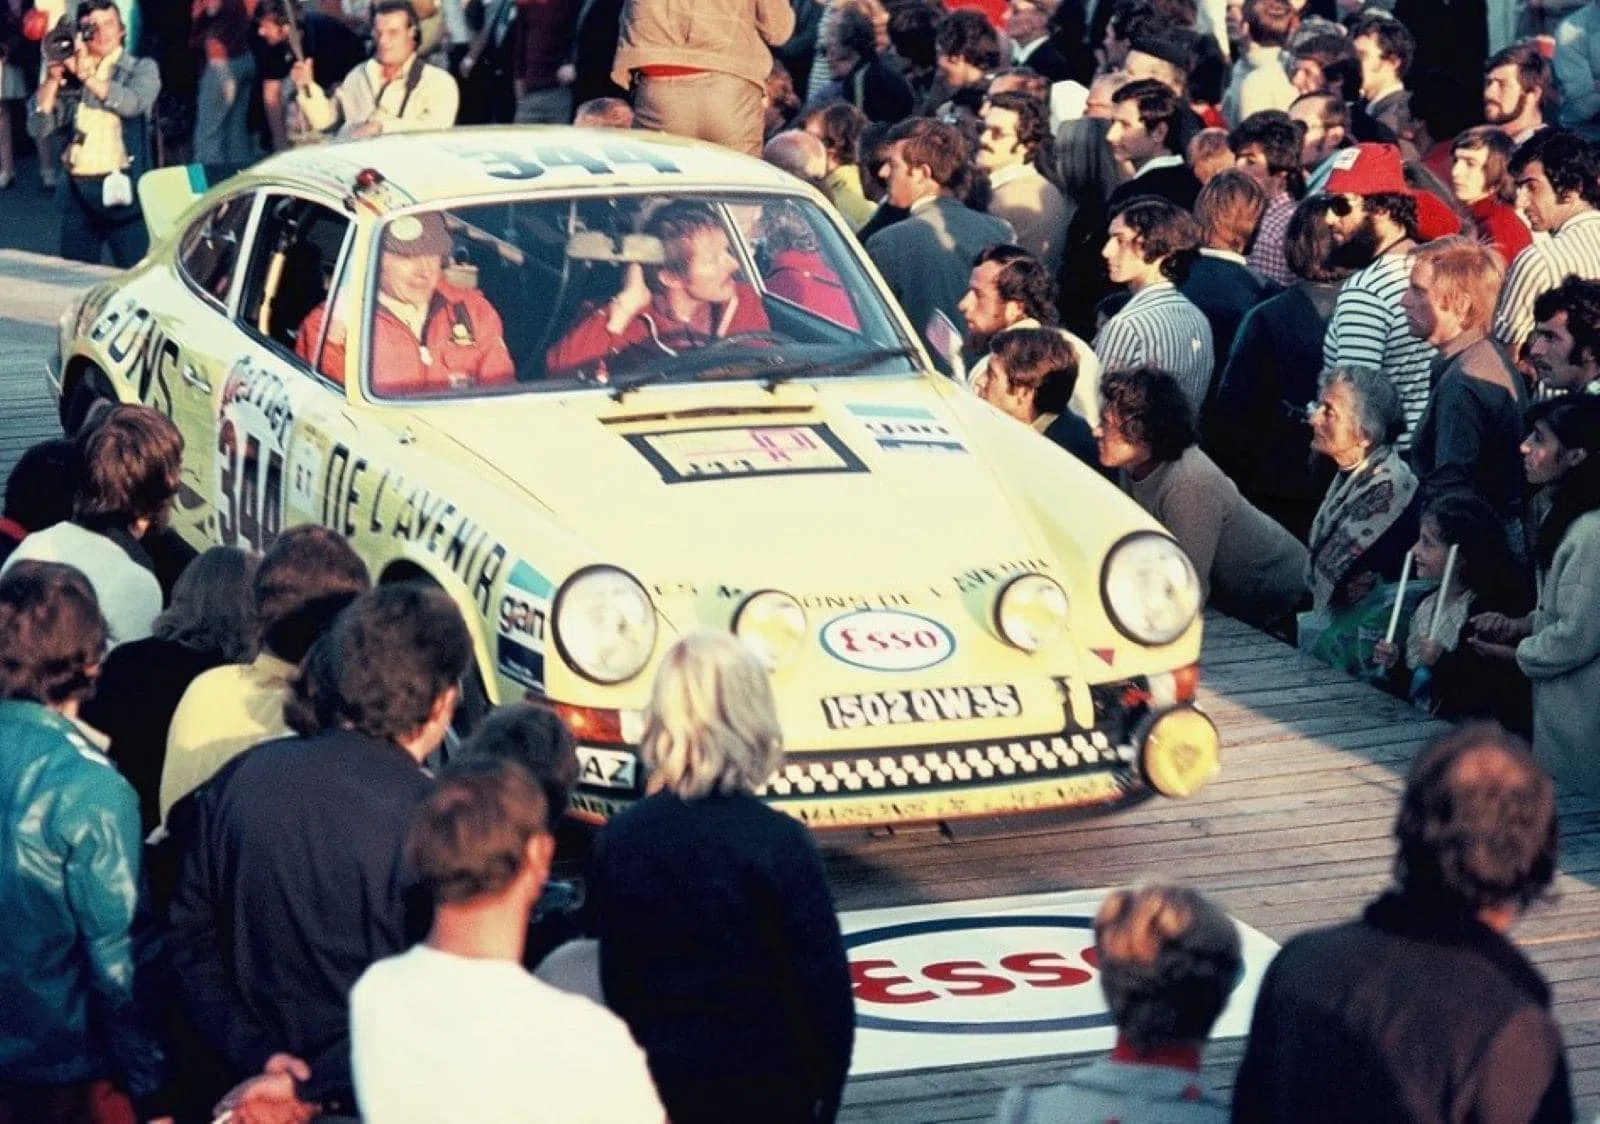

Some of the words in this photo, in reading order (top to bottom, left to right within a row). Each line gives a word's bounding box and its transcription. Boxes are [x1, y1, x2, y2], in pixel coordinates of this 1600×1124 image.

[323, 443, 367, 537] DE
[370, 468, 507, 616] L'AVENIR
[500, 595, 545, 641] gan
